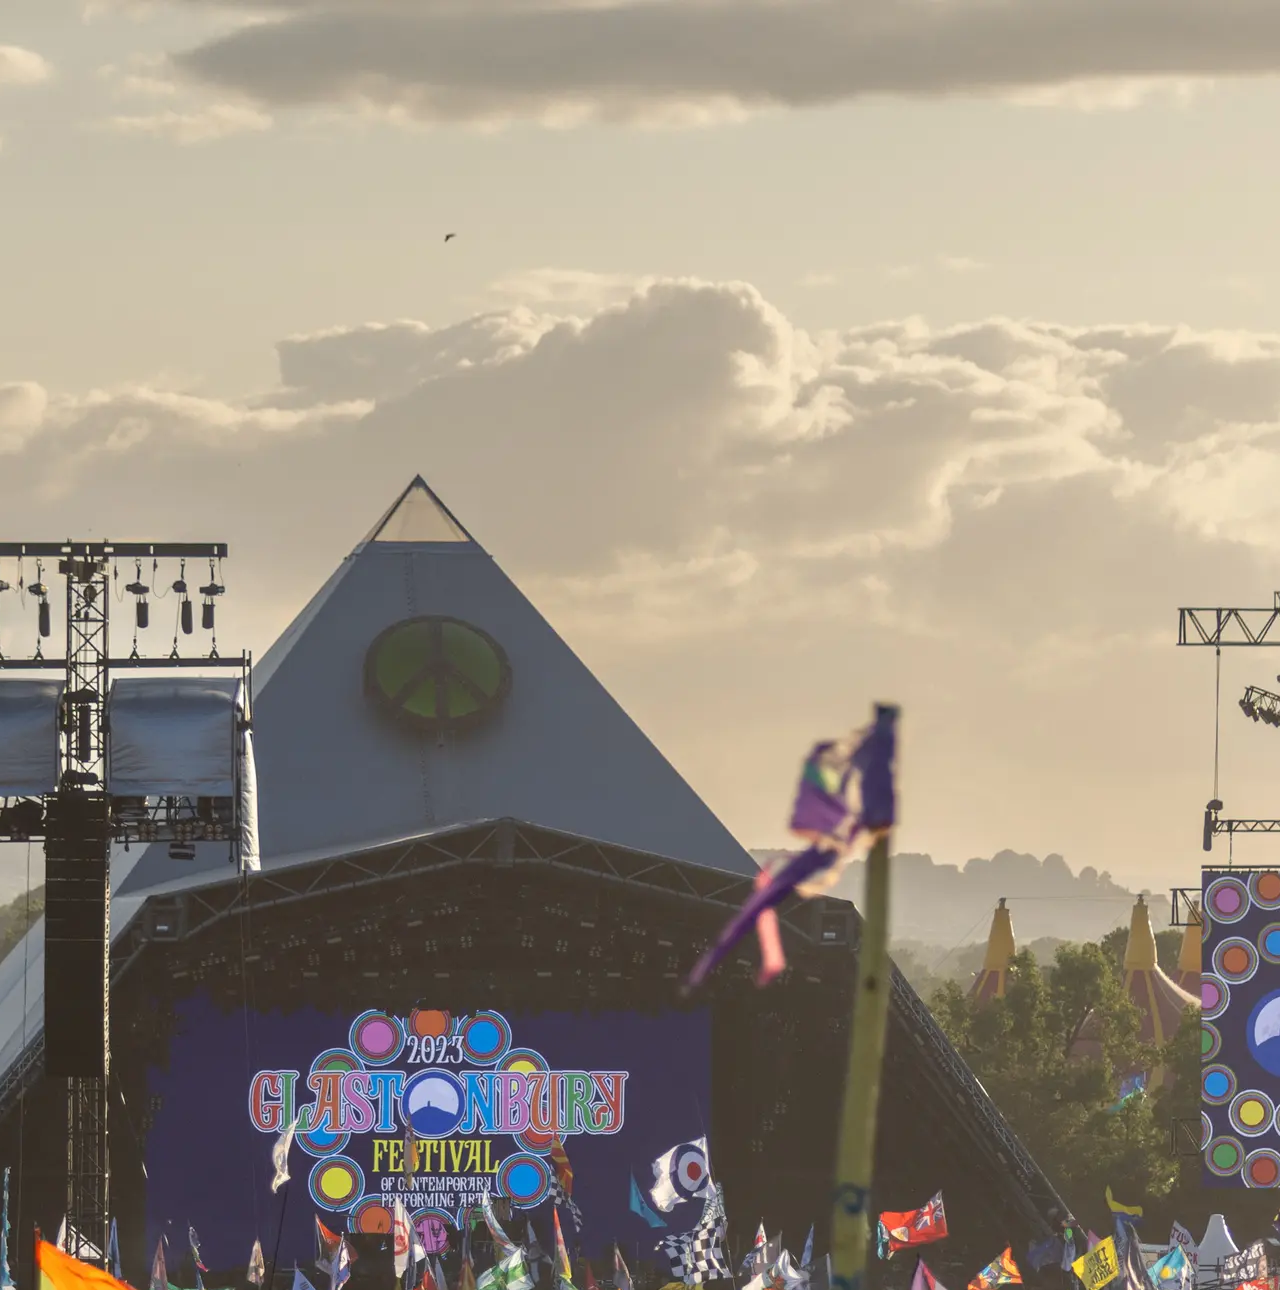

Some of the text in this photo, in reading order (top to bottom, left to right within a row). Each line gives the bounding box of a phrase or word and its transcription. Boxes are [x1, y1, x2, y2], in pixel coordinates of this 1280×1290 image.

[407, 1035, 465, 1064] 2023
[249, 1068, 629, 1137] GLASTONBURY
[381, 1176, 491, 1192] OF CNTEMPORARY
[458, 1192, 491, 1208] ART
